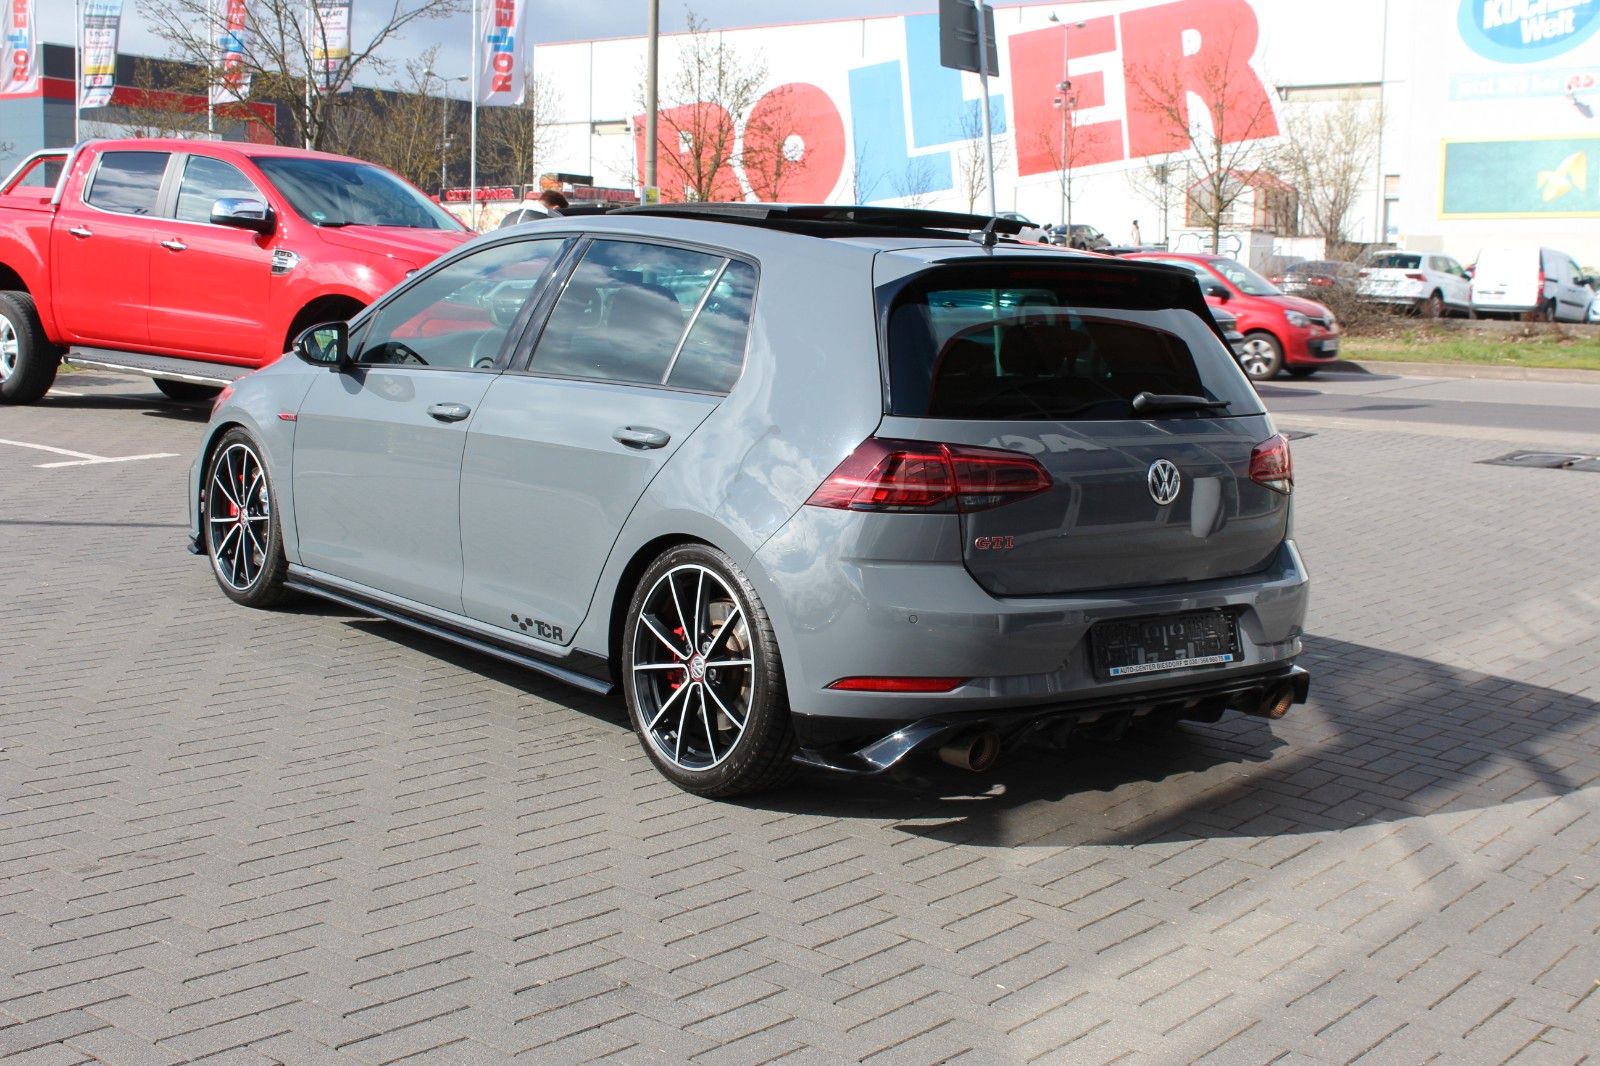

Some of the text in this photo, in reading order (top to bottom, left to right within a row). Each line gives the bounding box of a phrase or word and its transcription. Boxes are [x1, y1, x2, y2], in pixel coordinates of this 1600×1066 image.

[634, 0, 1280, 205] ROLLER
[974, 535, 1015, 551] GTI
[534, 619, 564, 642] TCR
